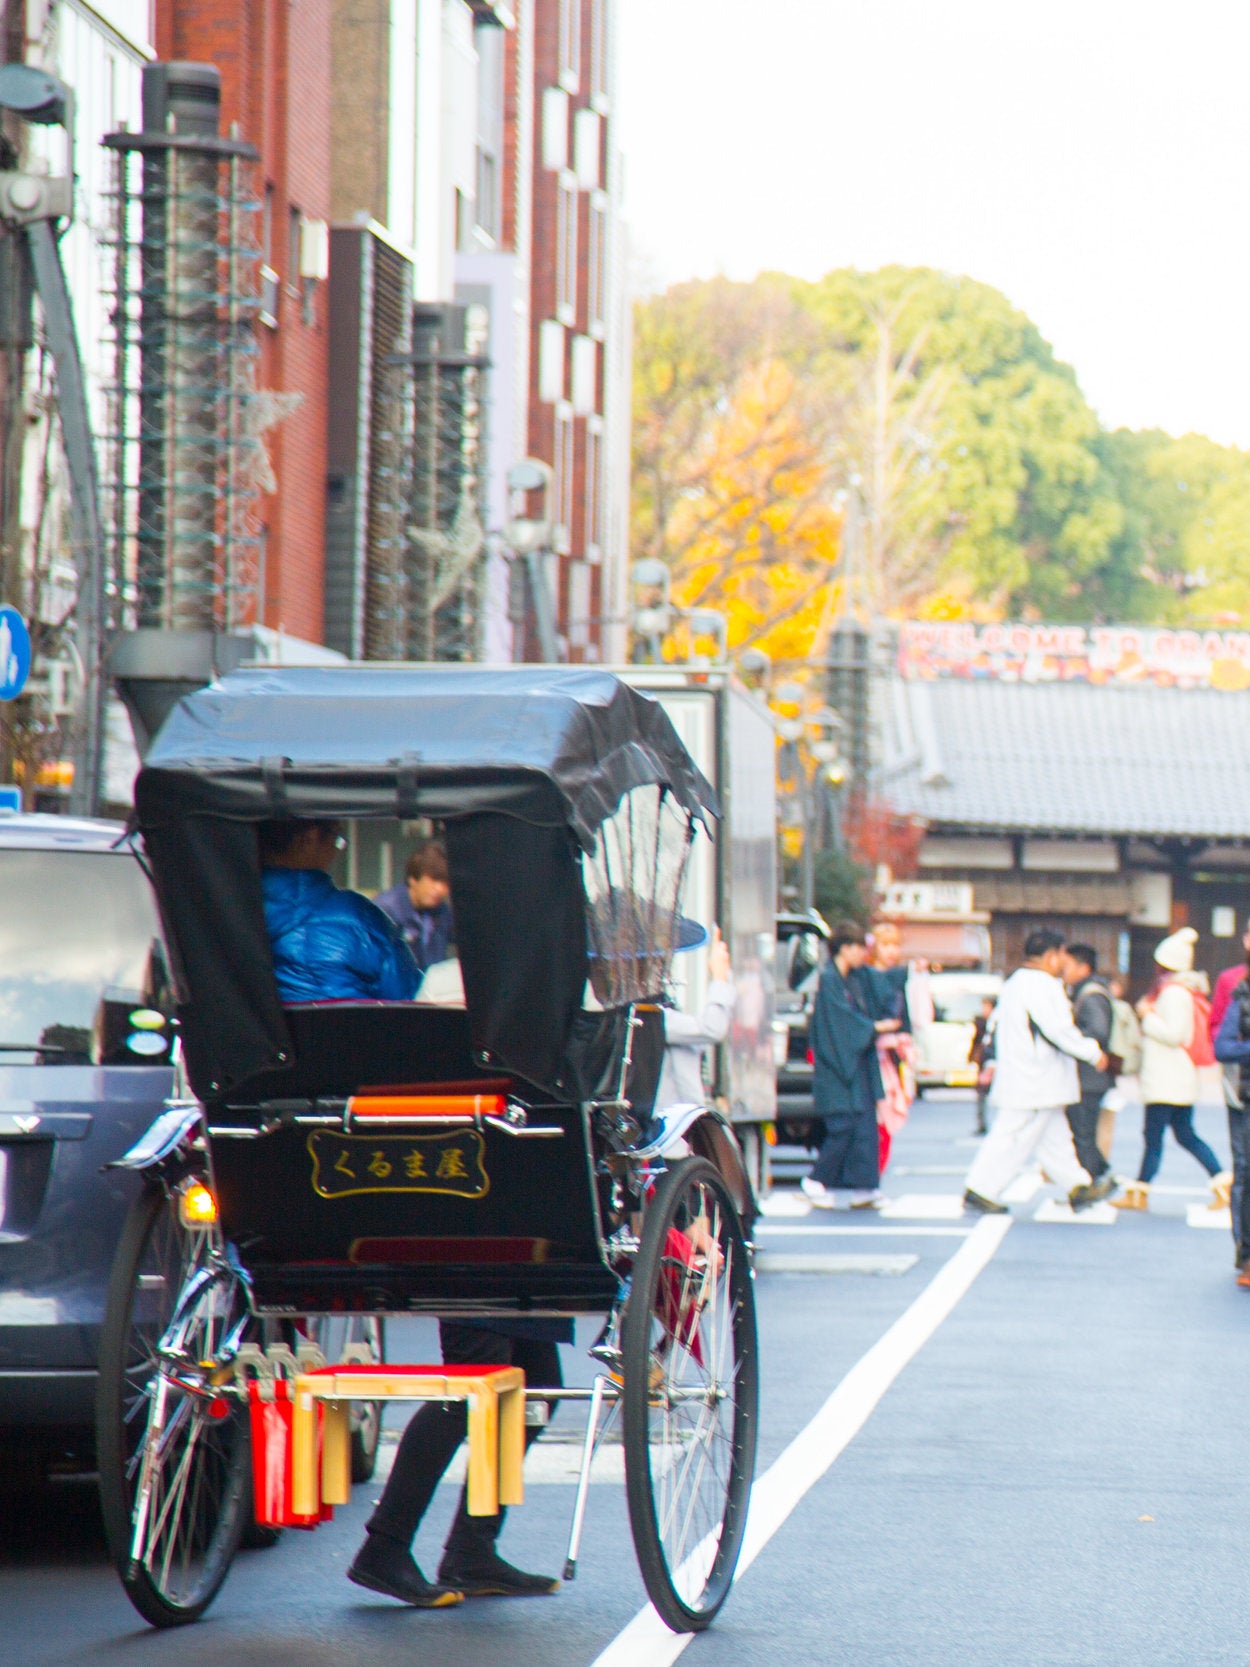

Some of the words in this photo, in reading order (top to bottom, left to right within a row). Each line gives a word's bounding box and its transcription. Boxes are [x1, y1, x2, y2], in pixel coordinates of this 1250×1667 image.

[907, 623, 1087, 656] WELCOME
[1093, 627, 1142, 656] TO
[334, 1148, 470, 1180] くるま屋
